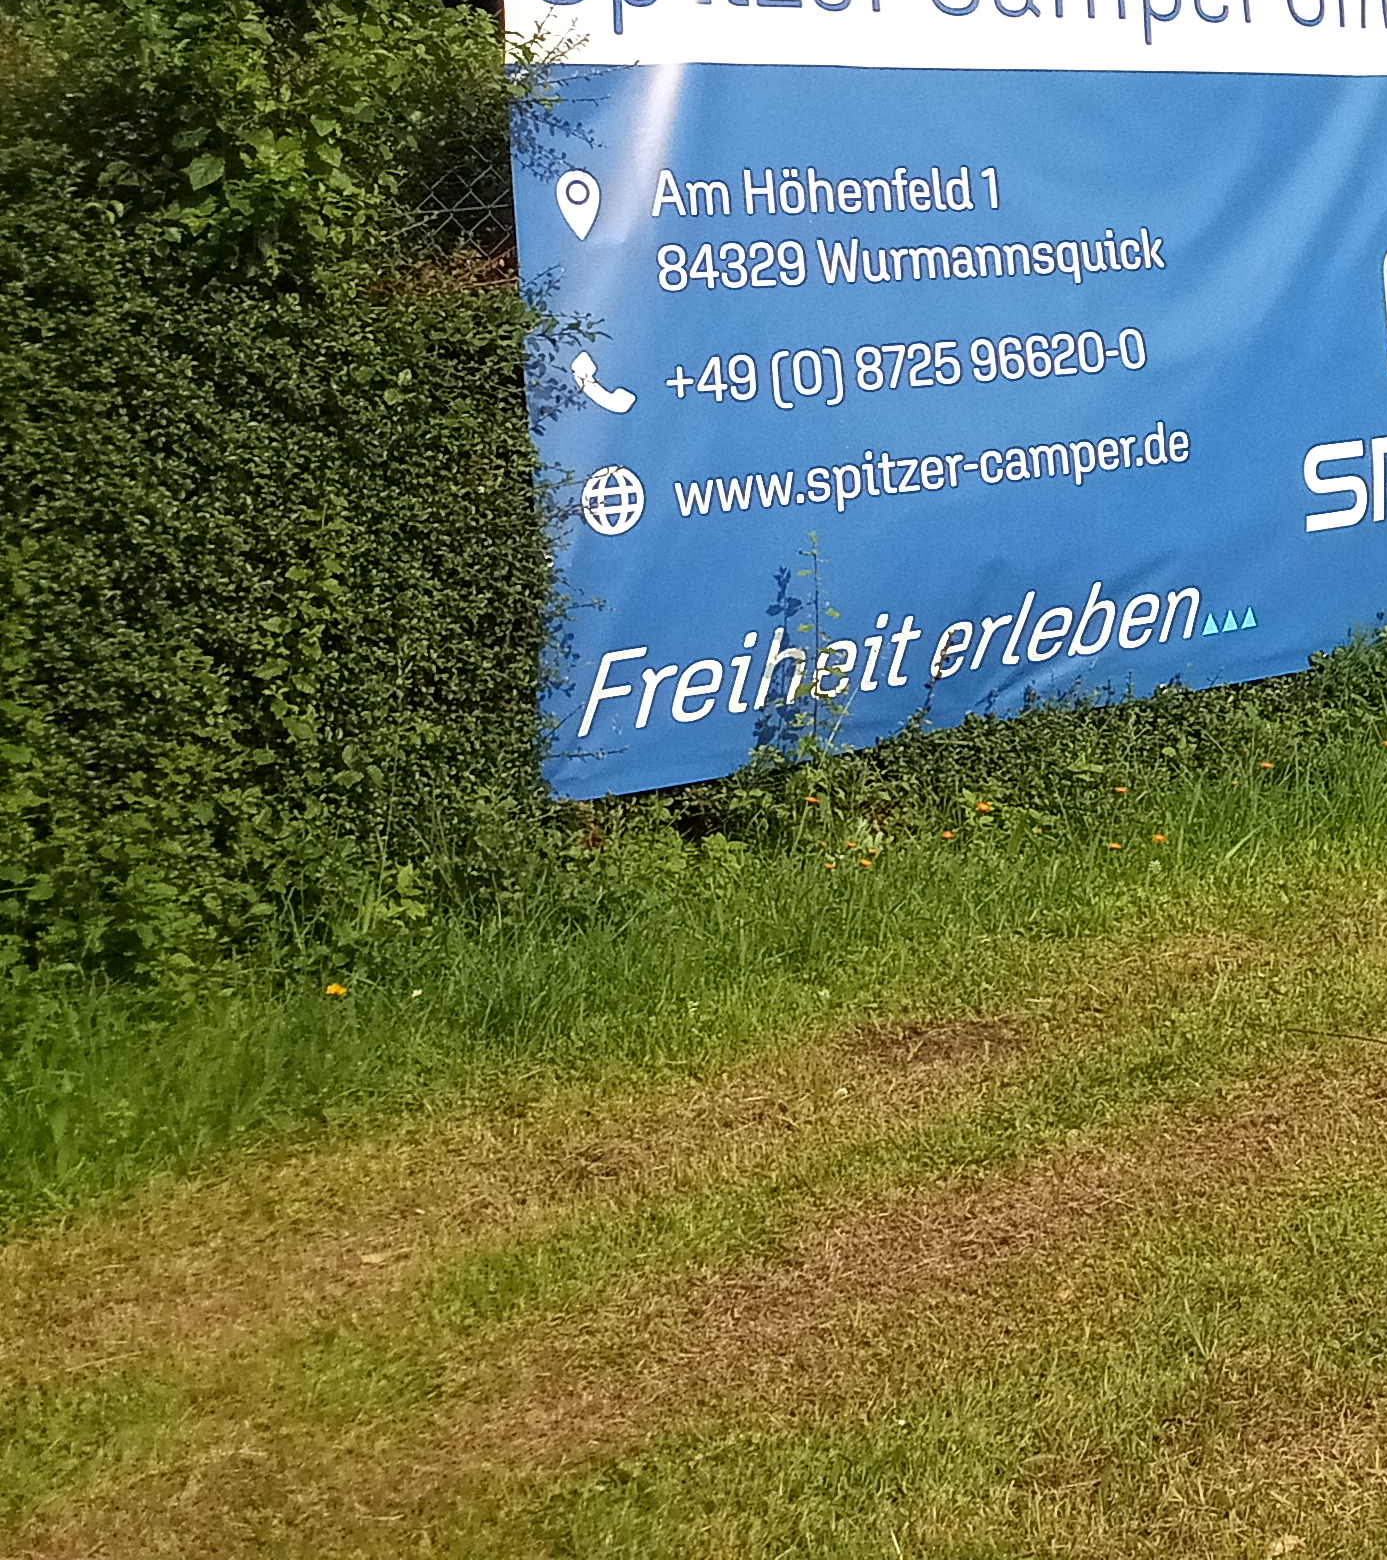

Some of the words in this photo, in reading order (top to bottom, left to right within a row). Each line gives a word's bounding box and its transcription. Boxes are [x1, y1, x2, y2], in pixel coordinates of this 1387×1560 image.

[652, 169, 731, 217] Am
[743, 167, 971, 216] Höhenfeld
[980, 167, 1000, 211] 1
[657, 240, 806, 291] 84329
[817, 228, 1166, 284] Wurmannsquick
[666, 354, 757, 402] +49
[771, 347, 845, 409] (0)
[854, 342, 961, 391] 8725
[971, 327, 1147, 383] 96620-0
[675, 420, 1190, 512] www.spitzer-camper.de
[577, 614, 922, 738] Freiheit
[928, 581, 1203, 680] erleben
